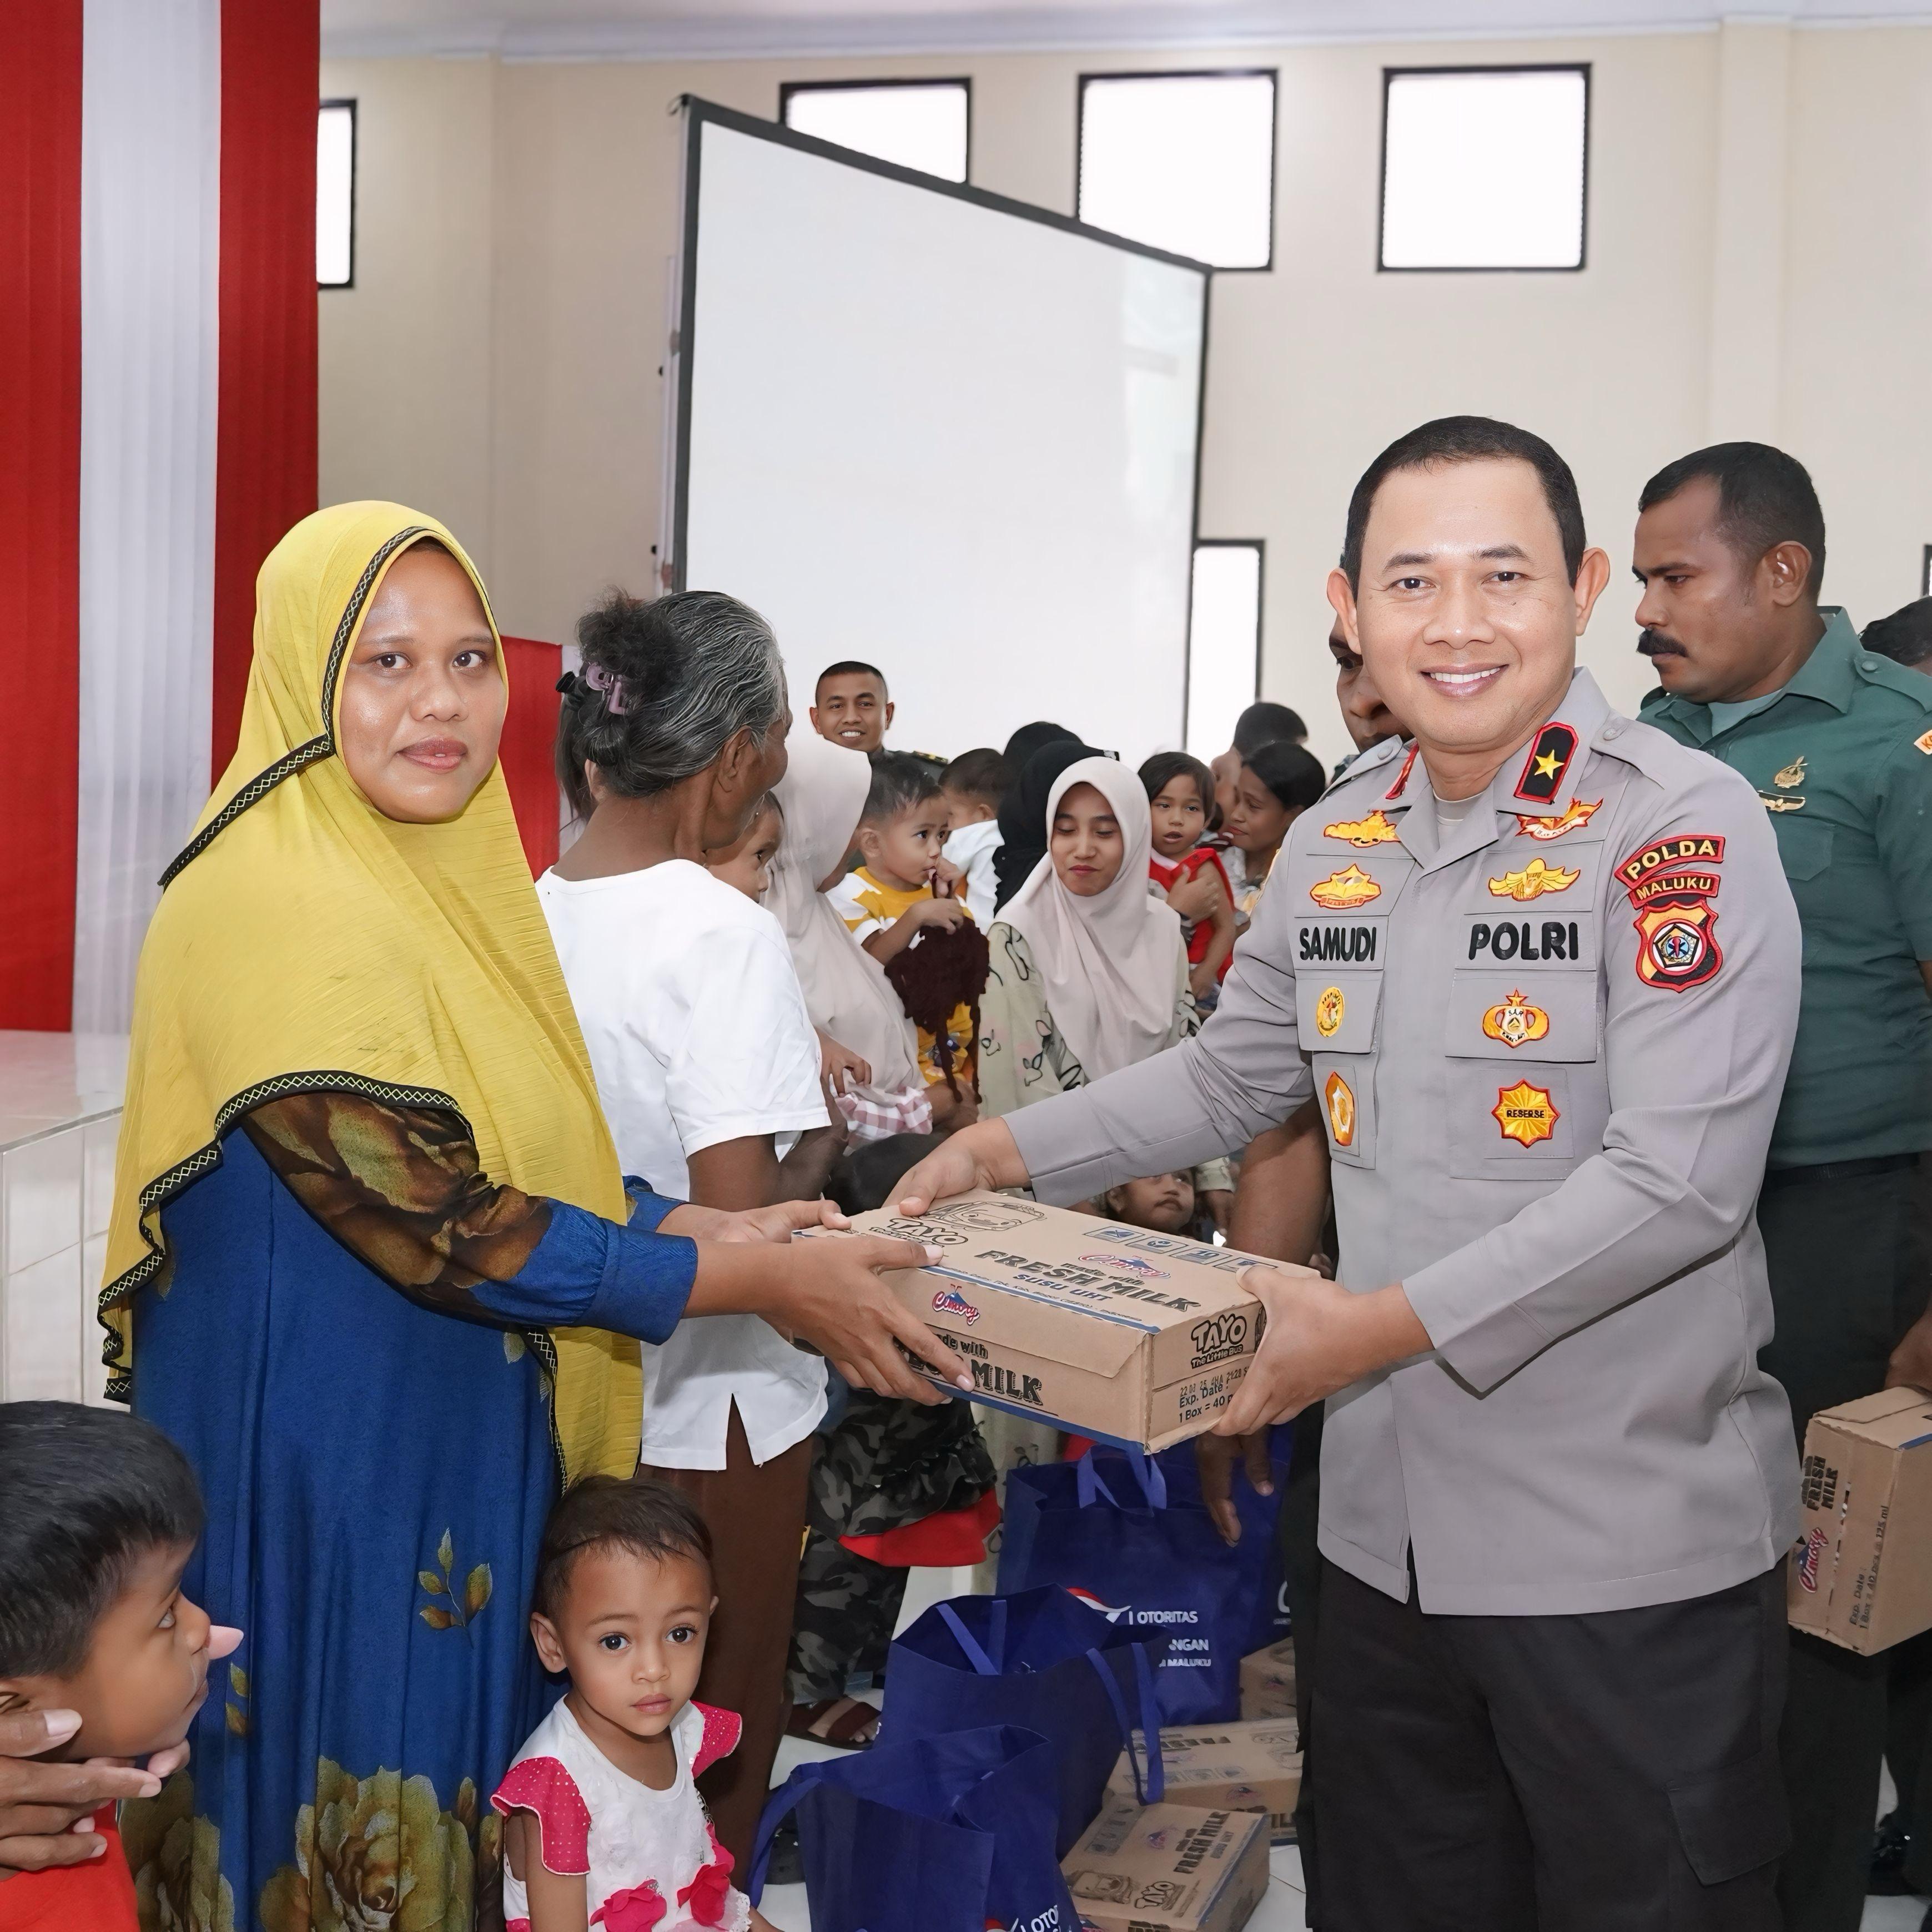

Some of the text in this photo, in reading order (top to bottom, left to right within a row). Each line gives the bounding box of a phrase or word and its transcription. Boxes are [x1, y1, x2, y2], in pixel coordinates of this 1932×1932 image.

[1627, 839, 1715, 880] POLDA
[1636, 877, 1711, 900] MALUKU
[1300, 926, 1376, 962] SAMUDI
[1468, 922, 1578, 960] POLRI
[1506, 1109, 1545, 1119] RESERSE
[887, 1218, 968, 1245] TAYO
[974, 1250, 1201, 1312] FRESH MILK
[1013, 1274, 1069, 1290] SUSU
[1069, 1289, 1114, 1301] UHT
[1191, 1313, 1247, 1354] TAYO
[960, 1341, 988, 1359] with
[1229, 1344, 1244, 1357] Bus
[970, 1359, 1043, 1406] MILK
[1180, 1395, 1199, 1408] Exp.
[1202, 1383, 1223, 1398] Date
[1179, 1412, 1182, 1422] 1
[1186, 1407, 1202, 1420] Box
[1213, 1396, 1225, 1407] 40
[1137, 1611, 1198, 1624] OTORITAS
[1031, 1905, 1059, 1932] OTO
